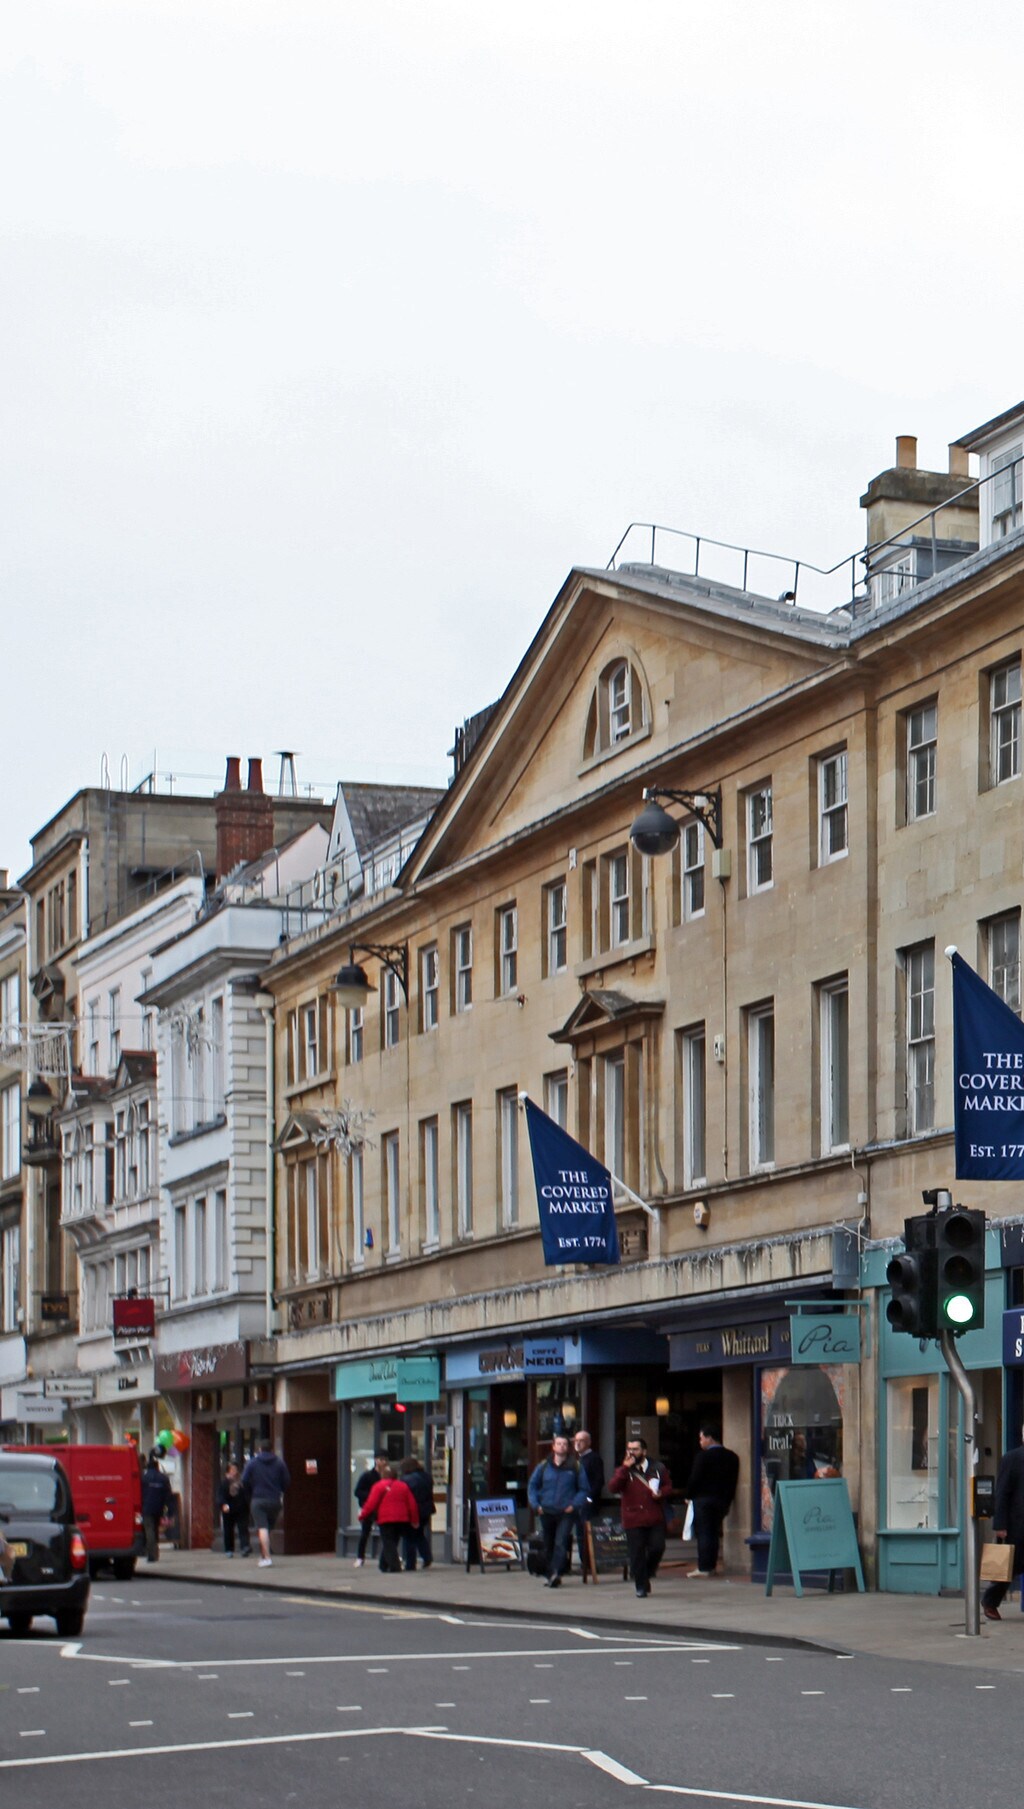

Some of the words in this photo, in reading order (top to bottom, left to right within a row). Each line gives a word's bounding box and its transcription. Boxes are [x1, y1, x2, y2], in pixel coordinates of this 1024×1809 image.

[983, 1053, 1023, 1069] THE
[558, 1170, 588, 1184] THE
[541, 1185, 608, 1199] COVERED
[549, 1201, 606, 1214] MARKET
[584, 1235, 606, 1247] 1774
[798, 1324, 854, 1355] Pia
[525, 1357, 565, 1367] NERO
[773, 1414, 794, 1427] TRICK
[769, 1431, 795, 1450] treat?
